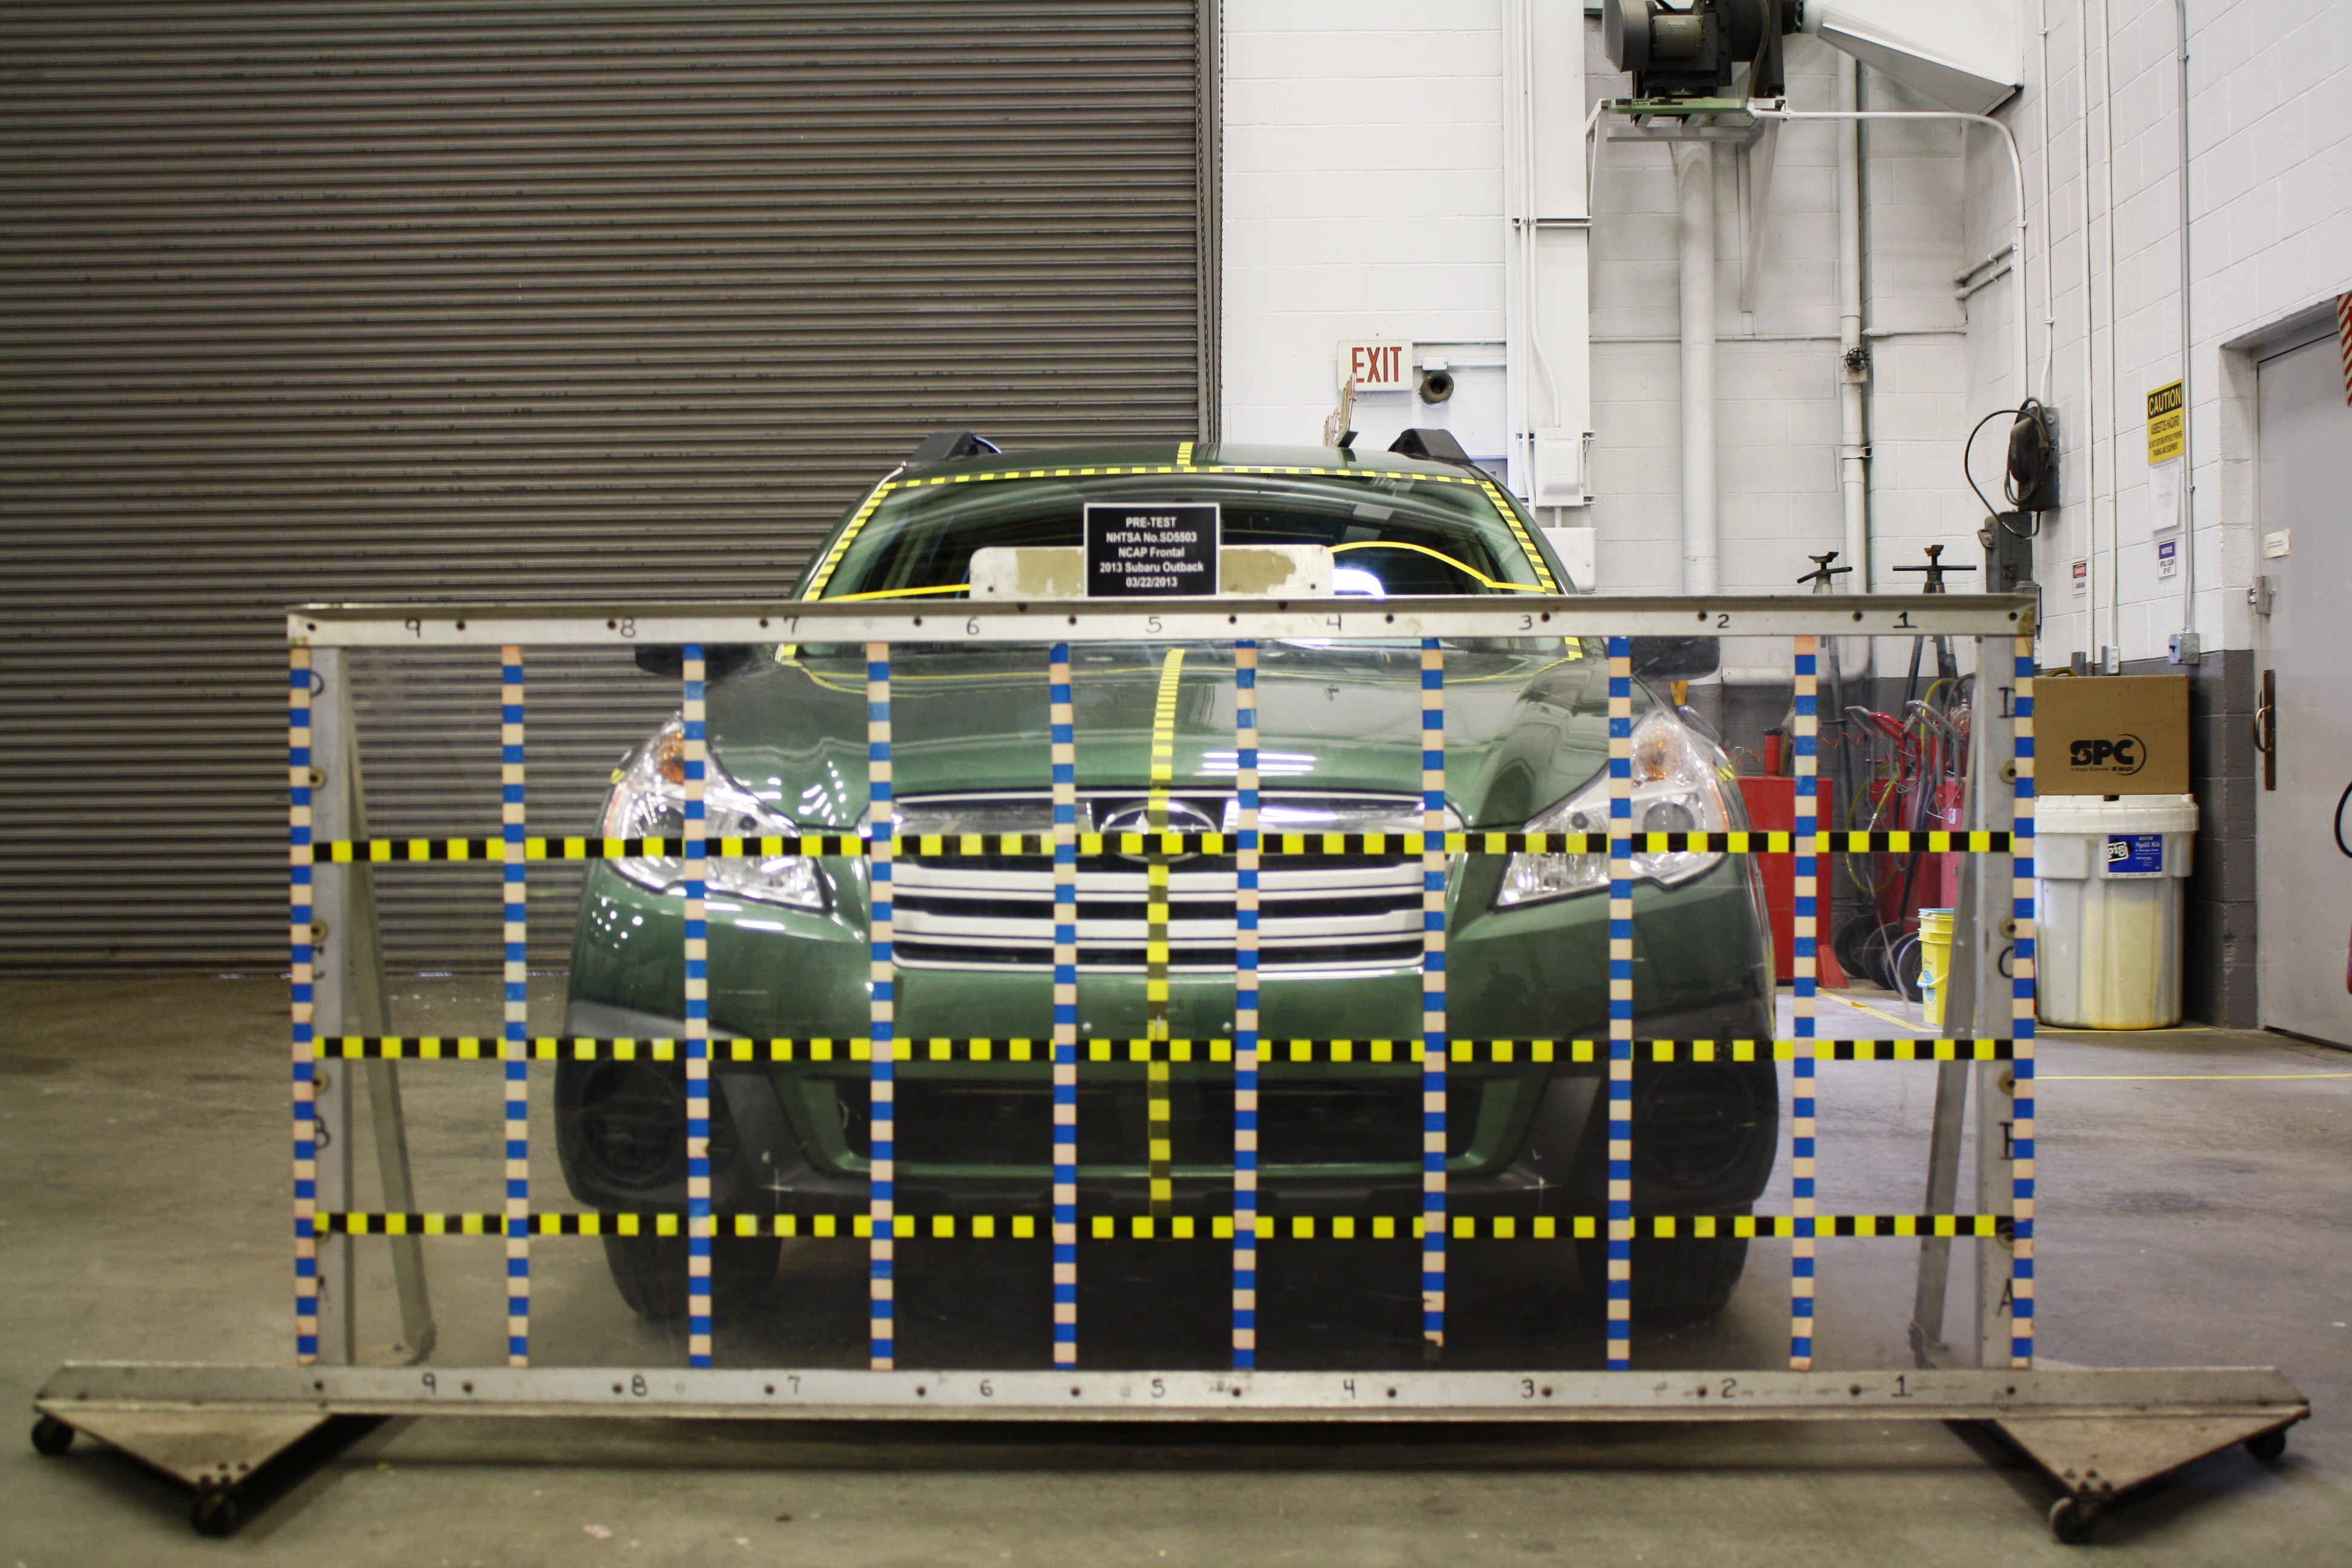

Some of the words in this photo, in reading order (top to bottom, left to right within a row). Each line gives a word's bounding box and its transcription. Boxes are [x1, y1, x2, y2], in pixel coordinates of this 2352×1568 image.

[1351, 347, 1402, 383] EXIT
[2149, 387, 2181, 416] CAUTION
[1126, 517, 1176, 528] PRE-TEST
[1106, 532, 1141, 543] NHTSA
[1119, 547, 1148, 558] NCAP
[1150, 547, 1184, 558] Frontal
[1100, 562, 1123, 573] 2013
[1125, 562, 1160, 573] Subaru
[1163, 561, 1204, 572] Outback
[1126, 577, 1178, 587] 03/22/2013
[405, 617, 420, 638] 9
[621, 616, 636, 638] 8
[785, 615, 800, 634] 7
[966, 616, 980, 635] 6
[1146, 616, 1163, 633] 5
[1327, 614, 1342, 630] 4
[1518, 614, 1533, 630] 3
[1717, 613, 1730, 629] 2
[1893, 612, 1917, 629] 1
[2070, 739, 2134, 765] SPC
[422, 1373, 437, 1394] 9
[631, 1374, 648, 1397] 8
[788, 1375, 802, 1394] 7
[979, 1379, 993, 1397] 6
[1151, 1378, 1165, 1397] 5
[1343, 1379, 1356, 1398] 4
[1521, 1379, 1535, 1399] 3
[1721, 1377, 1737, 1399] 2
[1890, 1374, 1913, 1397] 1
